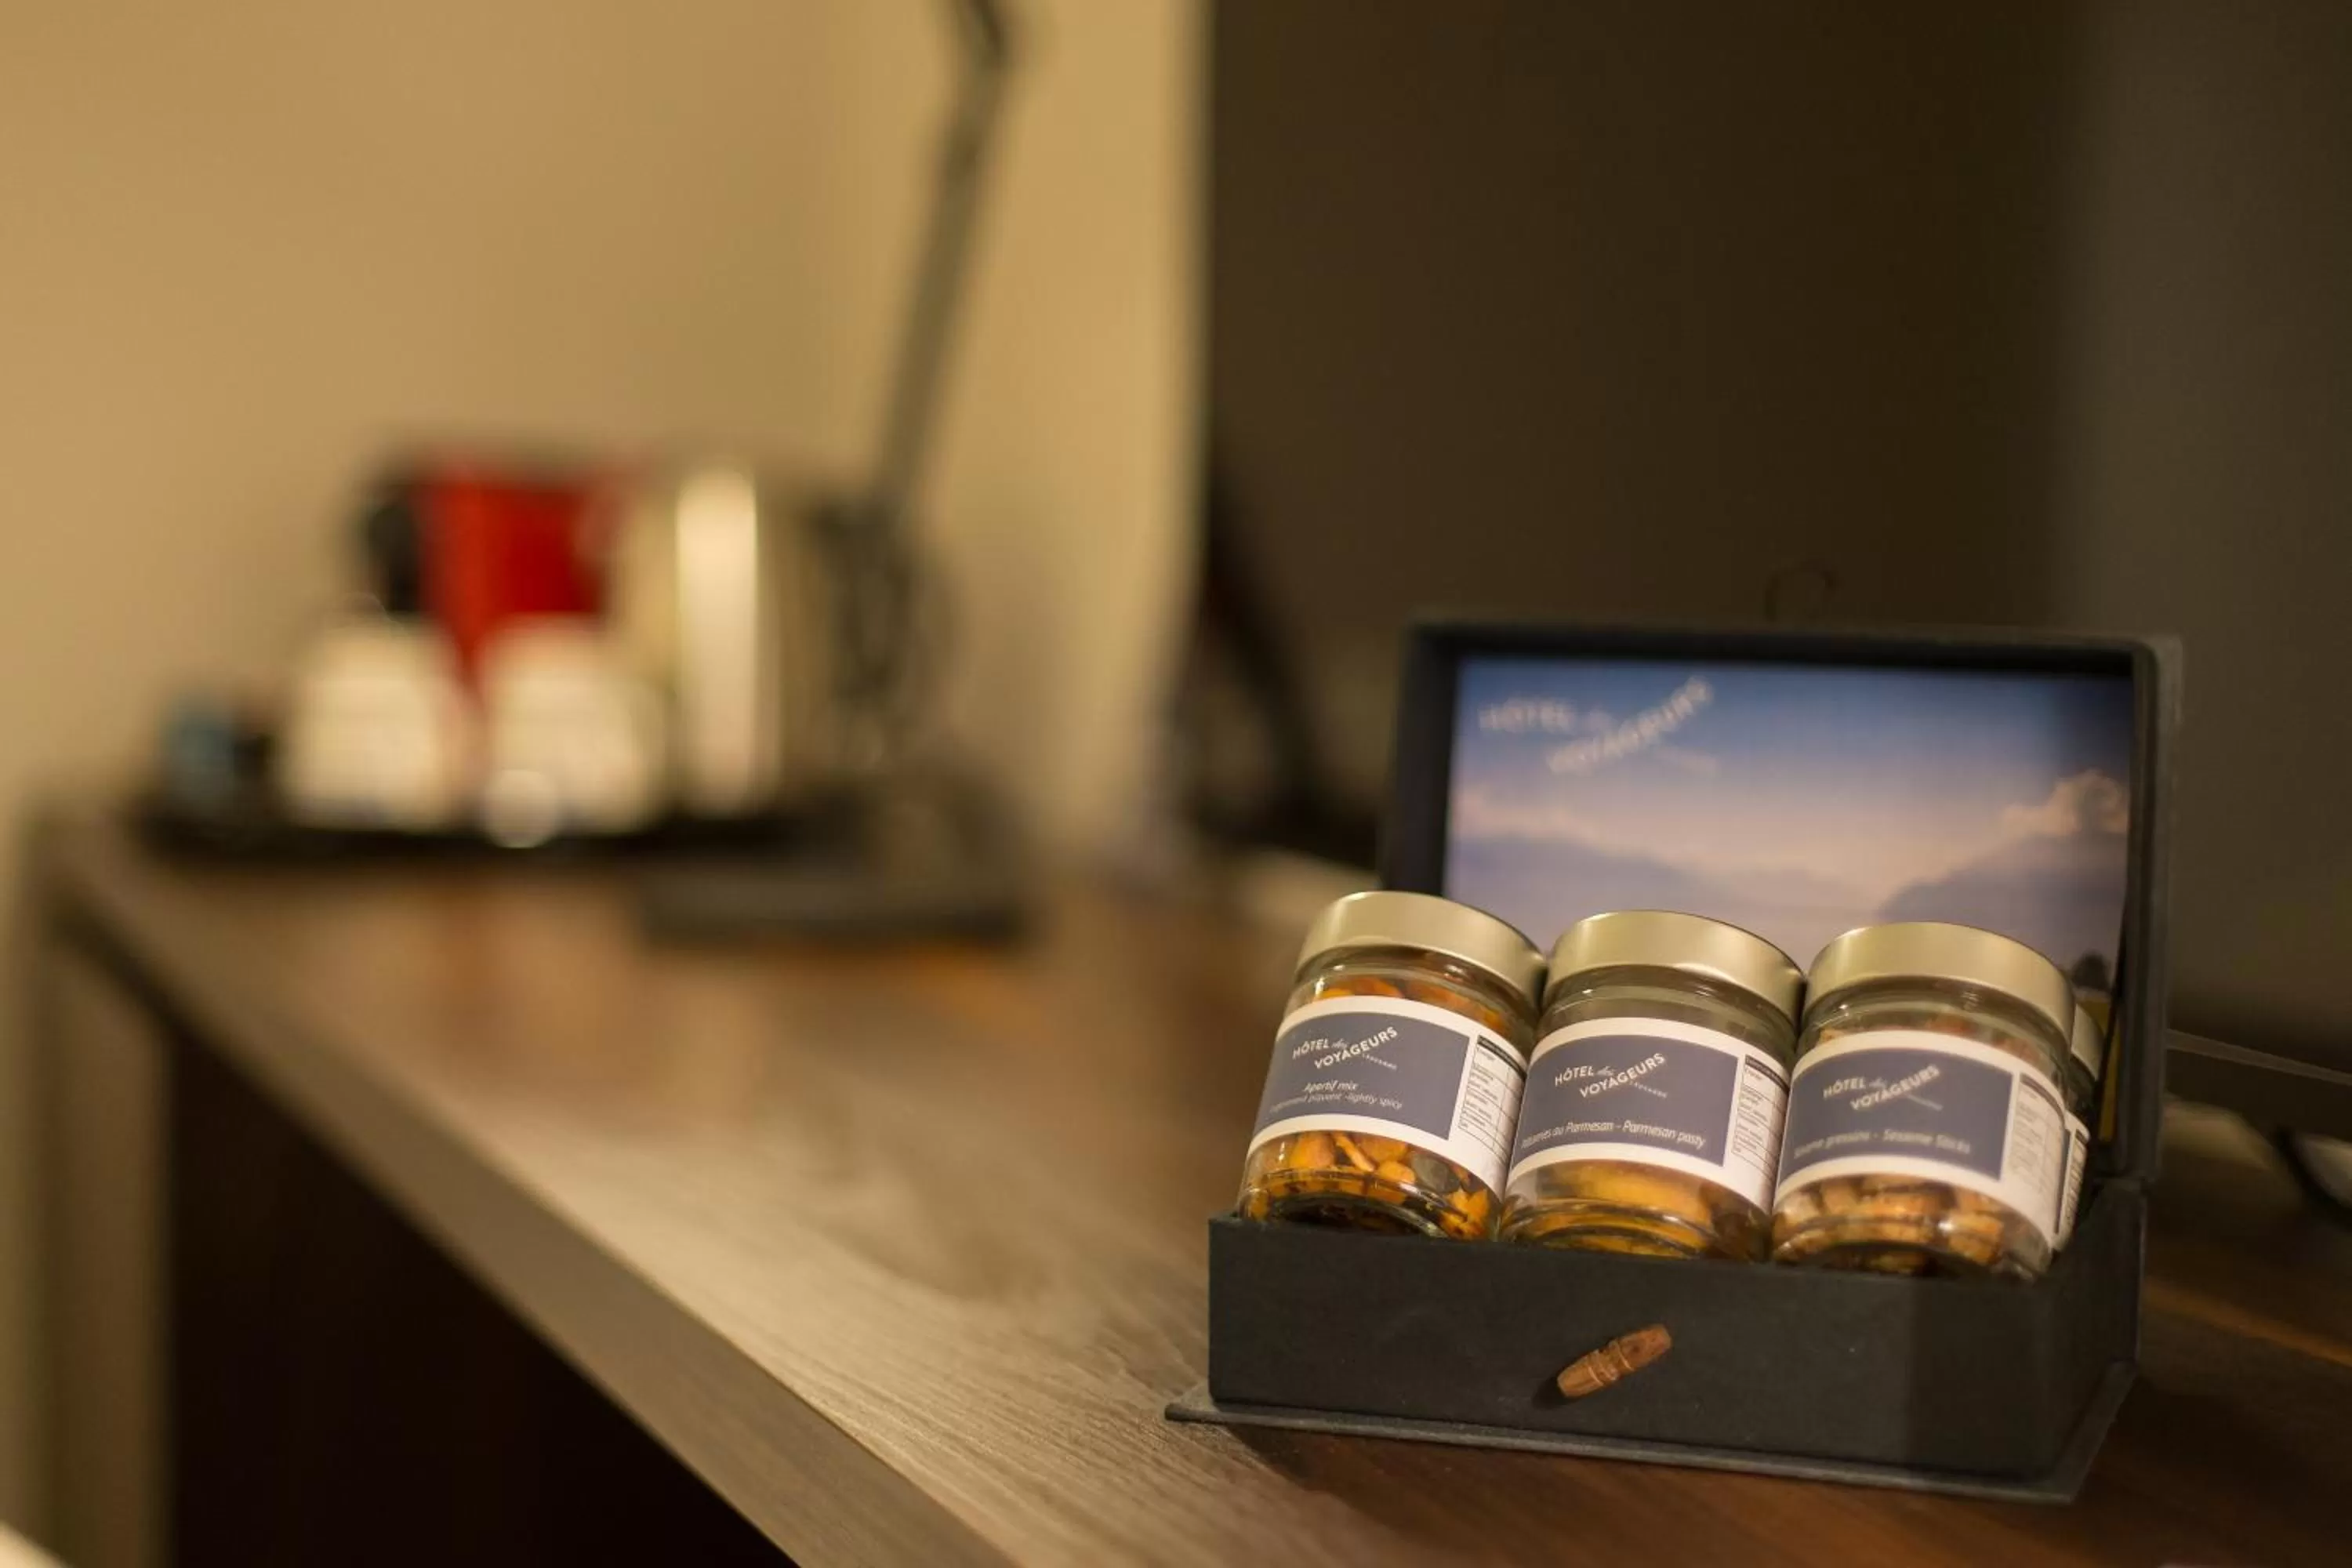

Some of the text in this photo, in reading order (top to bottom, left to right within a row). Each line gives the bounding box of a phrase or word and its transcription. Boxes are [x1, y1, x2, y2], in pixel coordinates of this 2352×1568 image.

[1293, 1038, 1329, 1059] HÔTEL
[1314, 1026, 1399, 1069] VOYAGEURS
[1555, 1065, 1594, 1087] HÔTEL
[1579, 1053, 1665, 1098] VOYAGEURS
[1823, 1077, 1866, 1099] HÔTEL
[1849, 1063, 1941, 1111] VOYAGEURS
[1566, 1121, 1614, 1134] Parmesan
[1622, 1119, 1676, 1138] Parmesan
